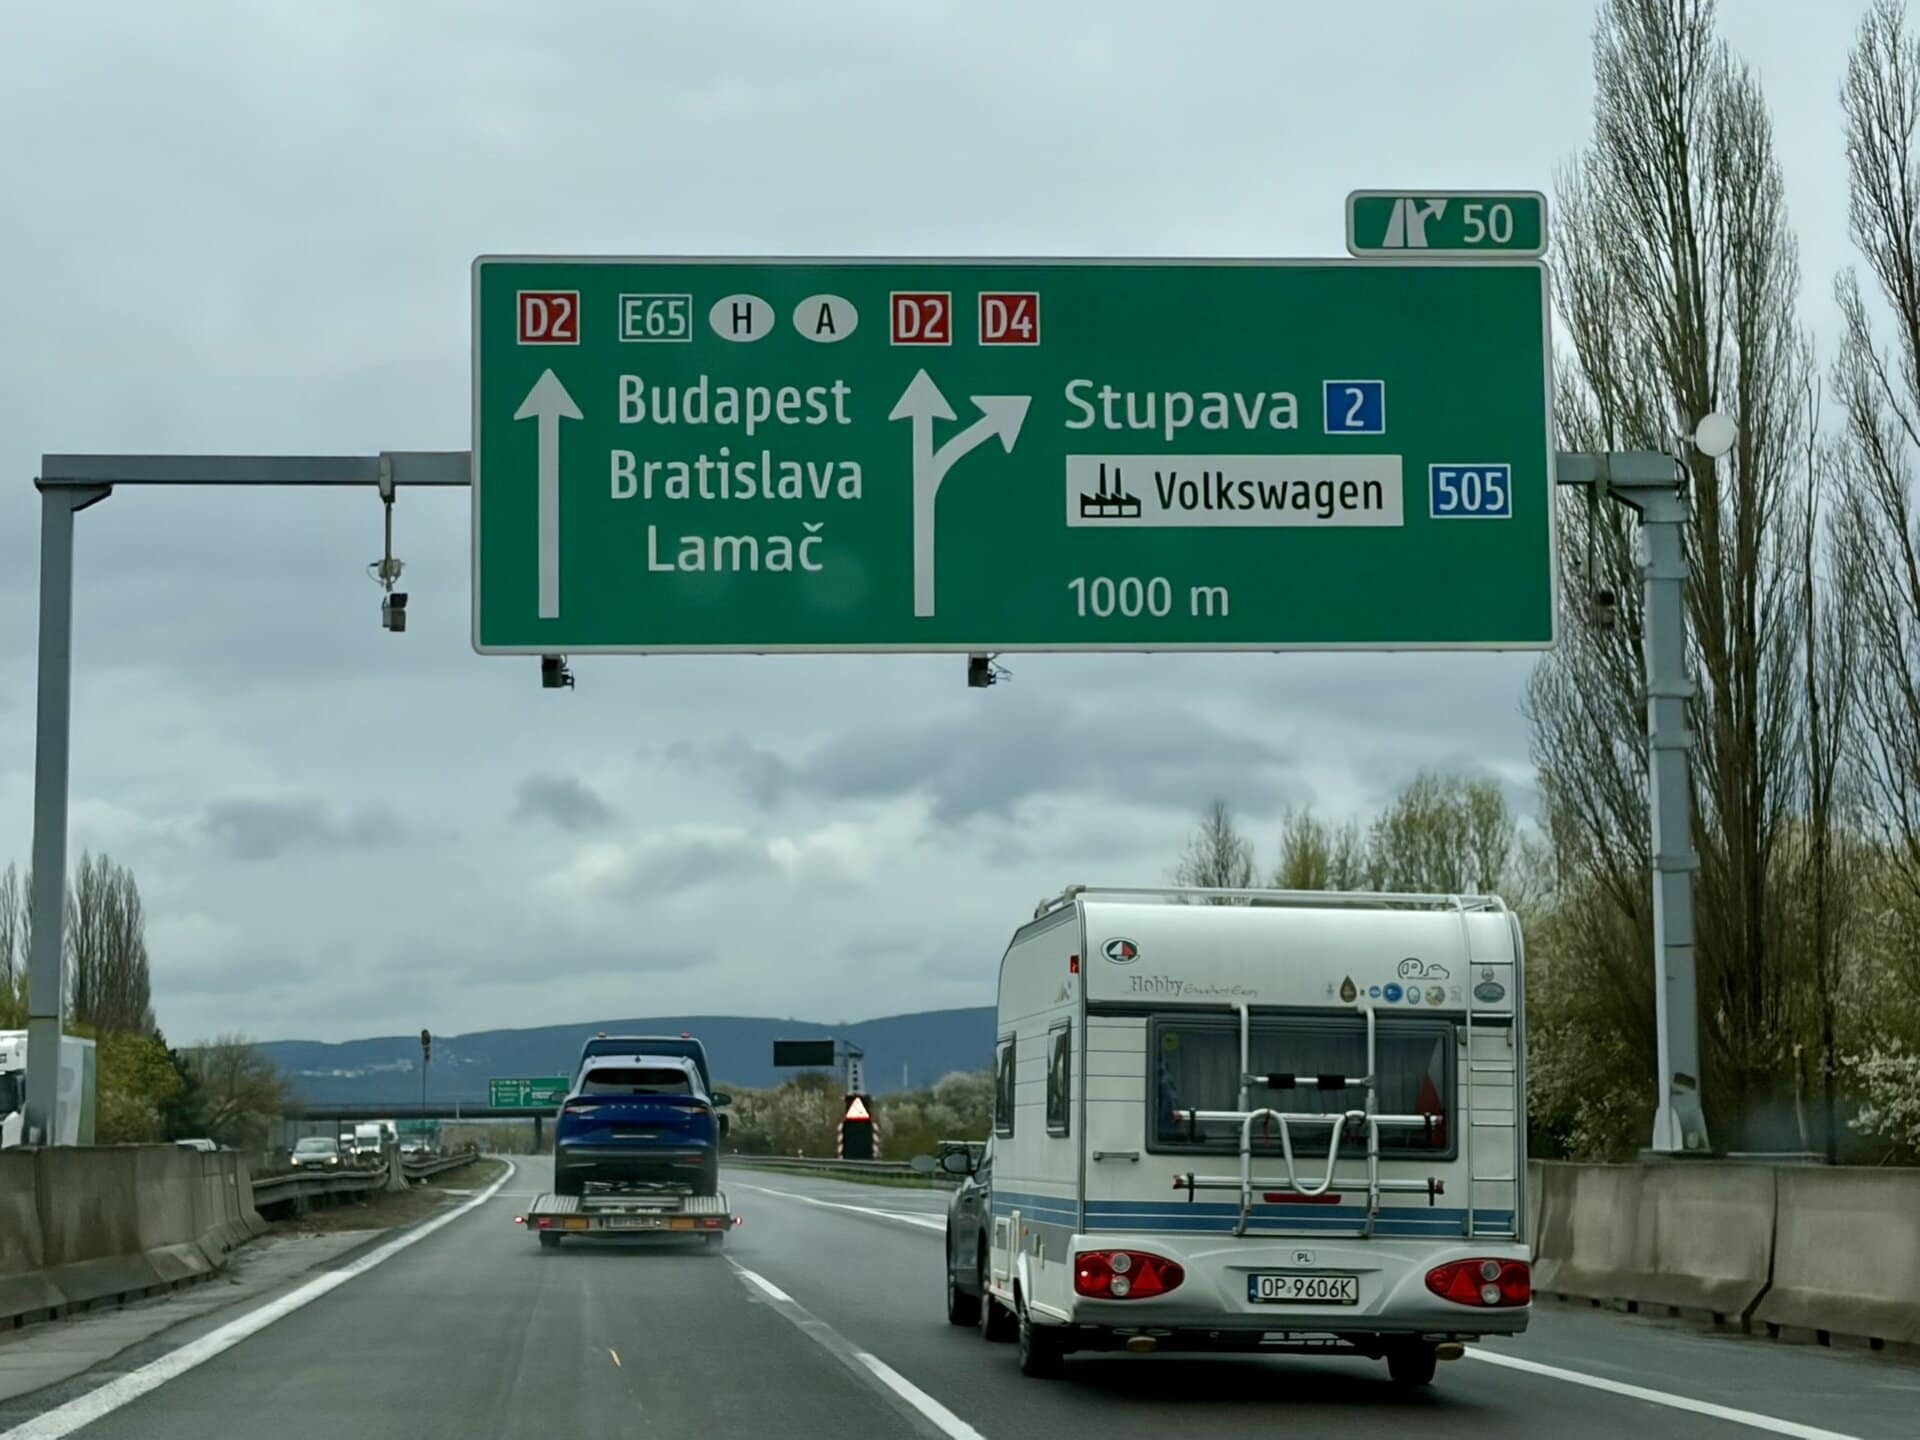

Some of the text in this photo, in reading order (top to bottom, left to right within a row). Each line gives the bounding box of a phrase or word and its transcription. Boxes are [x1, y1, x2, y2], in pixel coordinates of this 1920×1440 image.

[1463, 204, 1513, 243] 50
[525, 299, 572, 338] D2
[625, 300, 686, 336] E65
[732, 302, 752, 335] H
[815, 302, 836, 335] A
[898, 300, 943, 339] D2
[985, 300, 1033, 339] D4
[619, 374, 852, 436] Budapest
[1065, 379, 1298, 441] Stupava
[1345, 387, 1365, 427] 2
[610, 447, 862, 500] Bratislava
[1439, 471, 1505, 511] 505
[1154, 471, 1384, 519] Volkswagen
[647, 521, 824, 572] Lamač
[1068, 577, 1229, 617] 1000 m
[1129, 975, 1184, 997] Hobby
[1297, 1253, 1312, 1262] PL
[1293, 1279, 1352, 1299] 9606K
